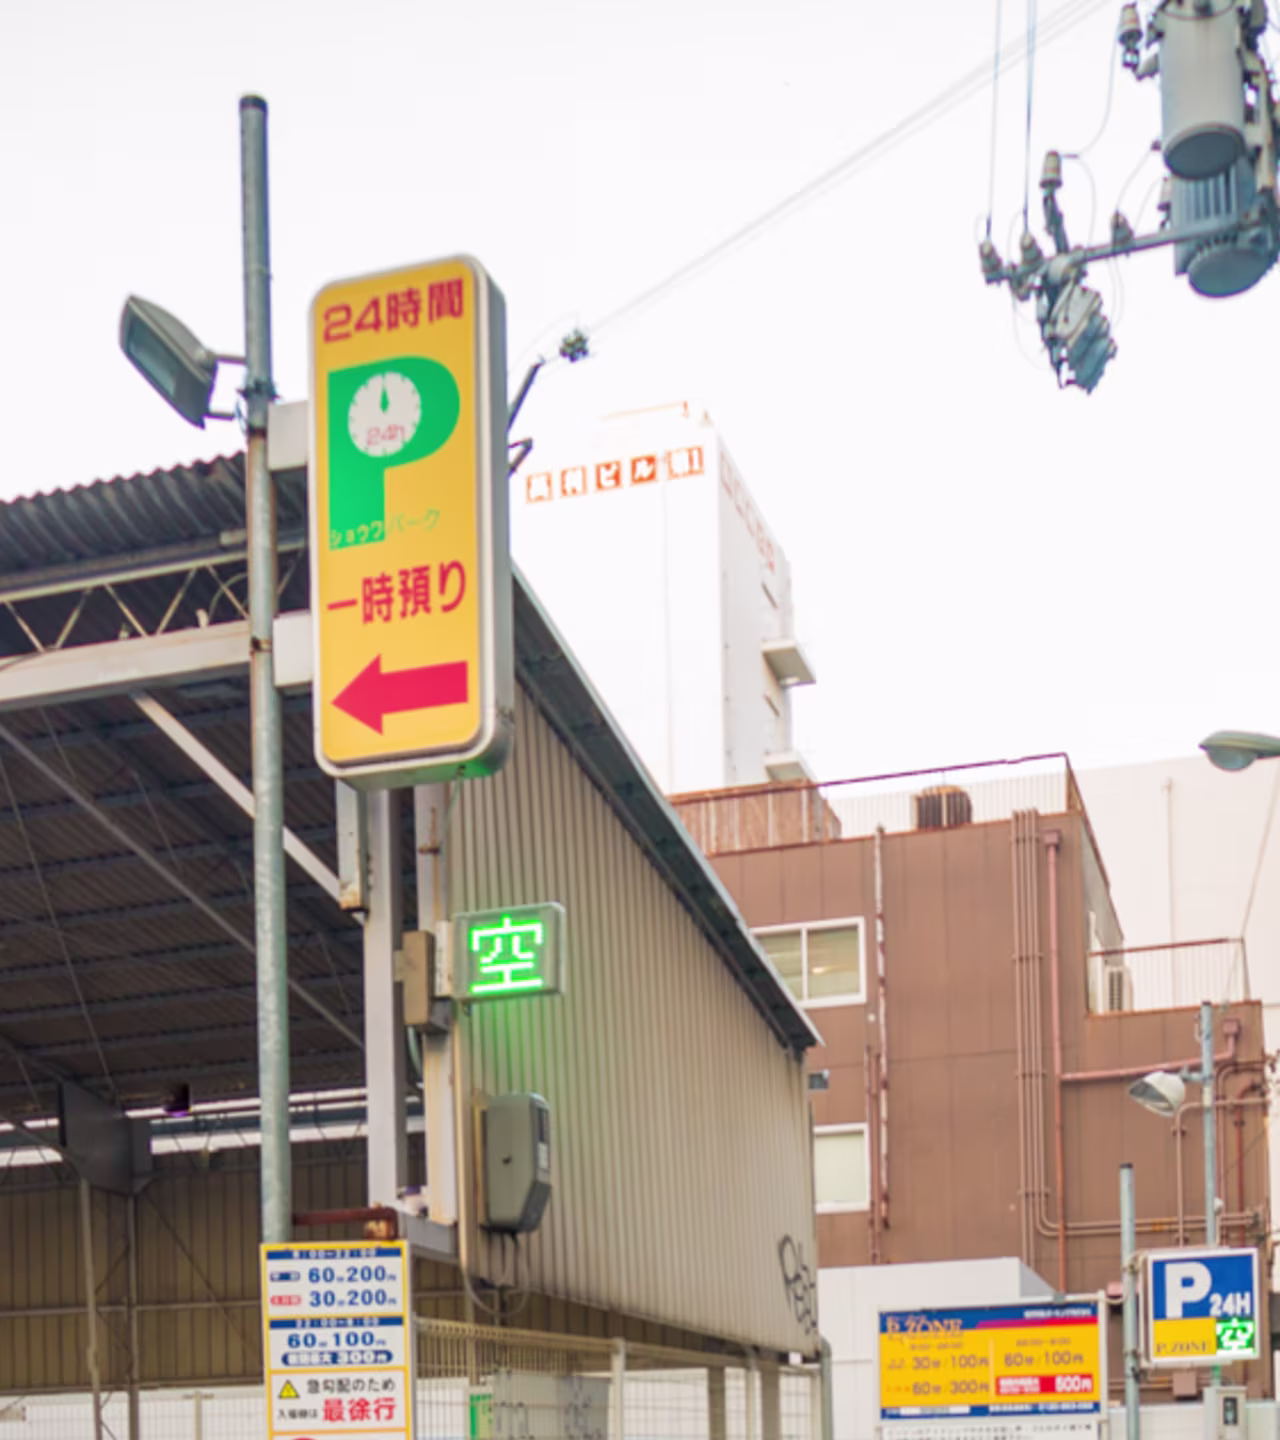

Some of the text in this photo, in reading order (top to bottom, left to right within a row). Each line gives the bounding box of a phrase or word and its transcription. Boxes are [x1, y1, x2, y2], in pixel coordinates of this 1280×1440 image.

[322, 277, 465, 344] 24時間
[326, 559, 467, 626] 一時預り
[470, 915, 544, 993] 空
[1164, 1260, 1213, 1319] P
[1209, 1291, 1251, 1317] 24H
[1216, 1316, 1255, 1355] 空
[306, 1378, 396, 1394] 急勾配のため
[321, 1397, 397, 1423] 最徐行
